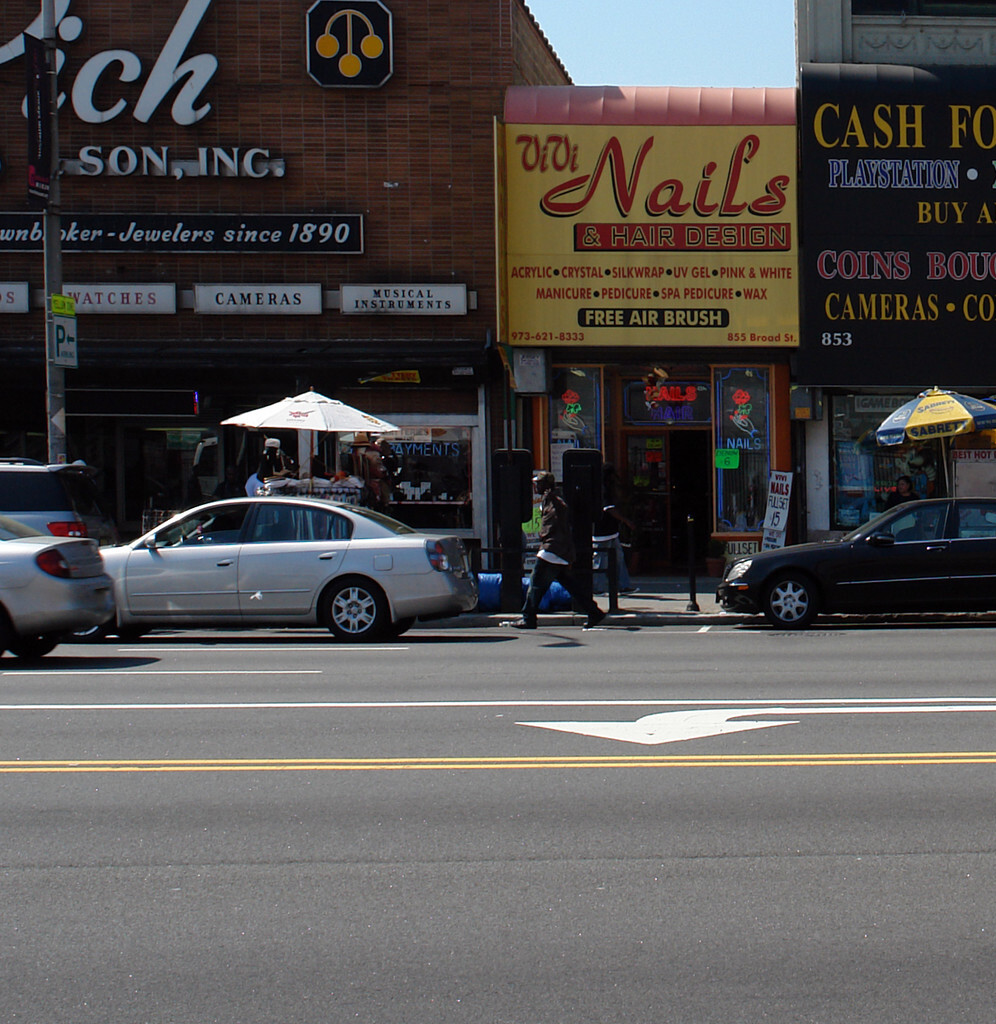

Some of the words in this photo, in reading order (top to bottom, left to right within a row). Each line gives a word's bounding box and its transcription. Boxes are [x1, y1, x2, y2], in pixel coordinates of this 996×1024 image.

[814, 103, 925, 150] CASH
[79, 146, 184, 180] SON,
[198, 147, 285, 178] INC.
[828, 159, 961, 189] PLAYSTATION
[917, 202, 968, 224] BUY
[0, 222, 214, 243] wnboker-Jewelers
[223, 224, 282, 243] since
[289, 223, 350, 244] 1890
[611, 226, 675, 247] HAIR
[686, 226, 787, 247] DESIGN
[817, 250, 911, 280] COINS
[511, 266, 552, 279] ACRYLIC
[562, 266, 604, 279] CRYSTAL
[612, 266, 665, 279] SILKWRAP
[674, 267, 688, 279] UV
[691, 267, 711, 279] GEL
[720, 267, 745, 279] PINK
[760, 267, 792, 280] WHITE
[67, 292, 157, 305] WATCHES
[215, 293, 302, 305] CAMERAS
[373, 289, 434, 298] MUSICAL
[536, 288, 592, 300] MANICURE
[602, 288, 652, 300] PEDICURE
[661, 288, 681, 301] SPA
[684, 288, 734, 301] PEDICURE
[743, 288, 768, 301] WAX
[355, 300, 451, 309] INSTRUMENTS
[825, 292, 939, 321] CAMERAS
[585, 310, 624, 326] FREE
[629, 310, 658, 326] AIR
[664, 310, 722, 326] BRUSH
[512, 332, 585, 342] 973-621-8333
[727, 332, 747, 343] 855
[750, 332, 781, 343] Broad
[784, 333, 797, 343] St.
[821, 332, 853, 346] 853
[974, 451, 991, 459] HOT
